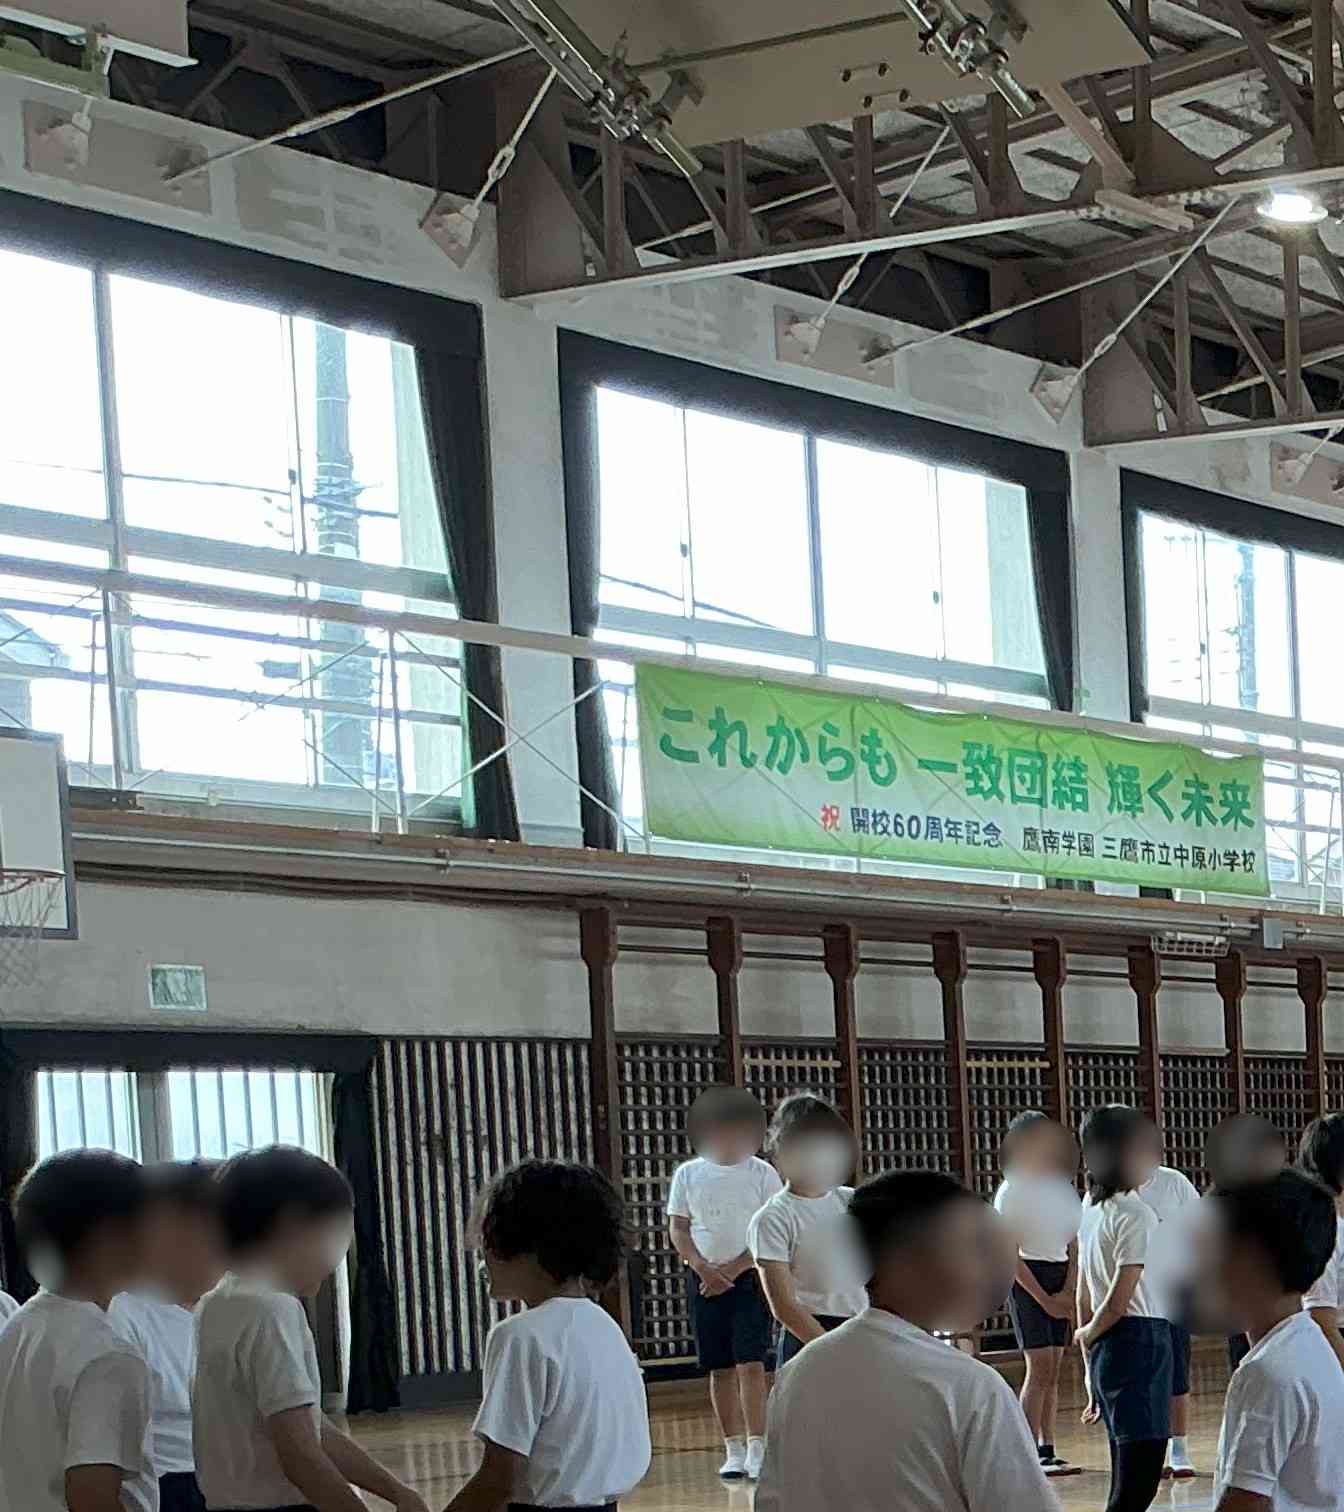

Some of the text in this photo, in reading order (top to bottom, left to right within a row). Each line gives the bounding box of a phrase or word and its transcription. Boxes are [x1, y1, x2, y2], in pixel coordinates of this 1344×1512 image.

[659, 705, 1256, 832] これからも 一致団結 輝く未来
[820, 803, 1257, 873] 祝 開校60周年記念 鷹南学園 三鷹市立中原小学校
